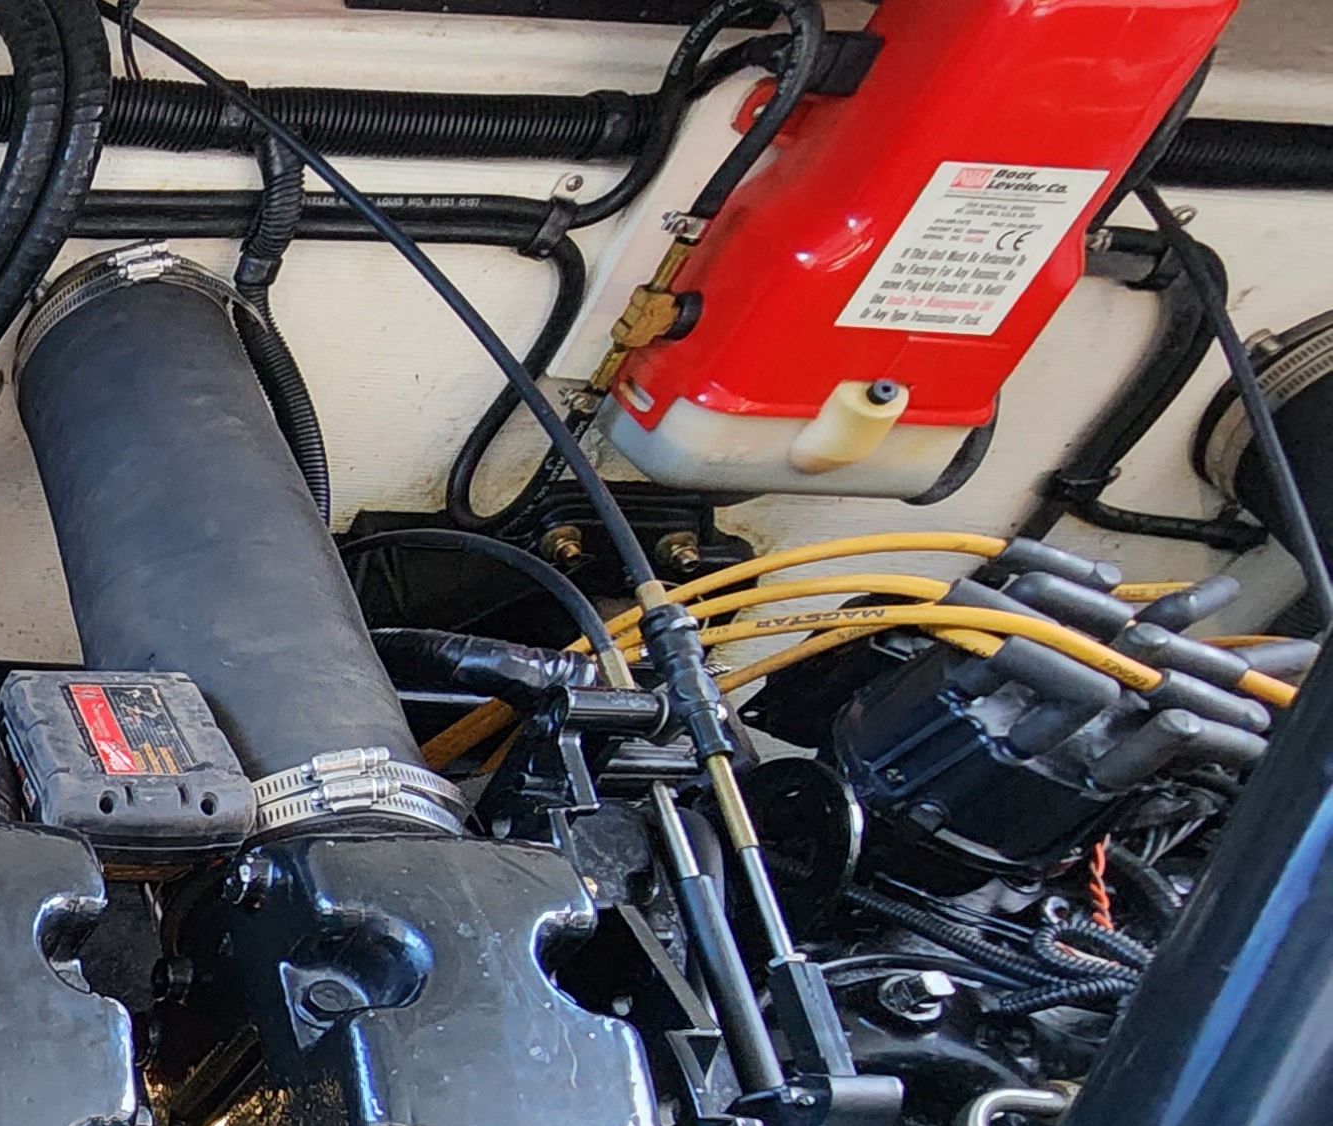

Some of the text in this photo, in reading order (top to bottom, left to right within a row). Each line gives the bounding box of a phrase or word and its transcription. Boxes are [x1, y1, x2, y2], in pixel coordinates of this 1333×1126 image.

[992, 169, 1038, 179] Boat
[984, 179, 1072, 193] Leveler Co.
[755, 608, 886, 630] MAGSTAR
